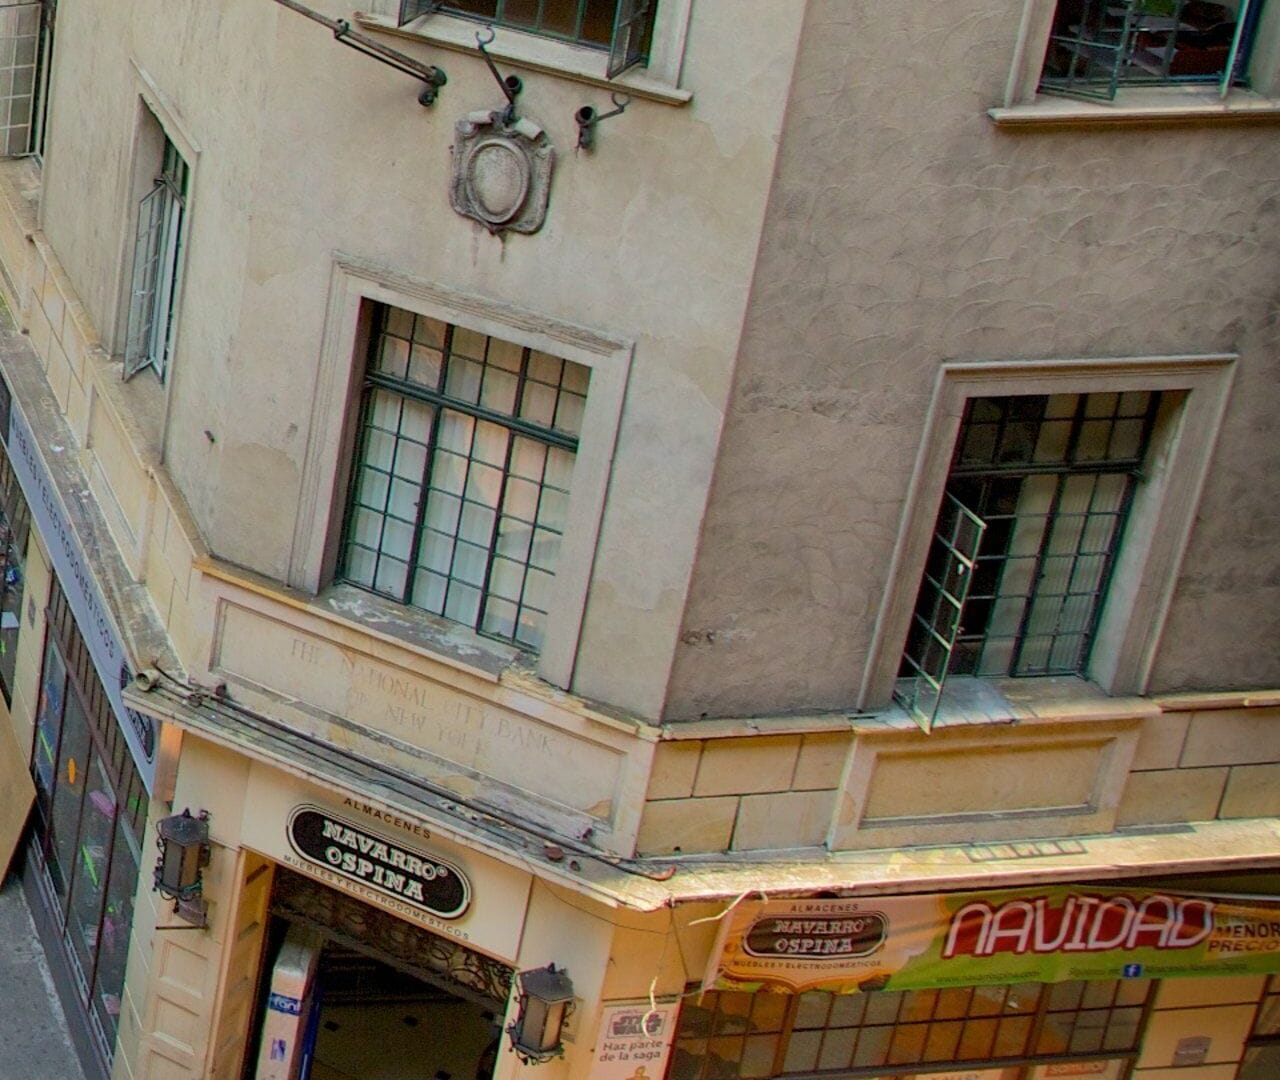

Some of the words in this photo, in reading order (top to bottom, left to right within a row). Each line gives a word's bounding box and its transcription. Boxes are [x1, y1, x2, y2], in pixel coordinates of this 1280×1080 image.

[343, 797, 432, 840] ALMACENES
[322, 819, 438, 881] NAVARRO
[283, 854, 335, 882] MUEBLES
[325, 846, 425, 902] OSPINA
[791, 903, 859, 913] ALMACENES
[772, 919, 865, 935] NAVARRO
[943, 892, 1215, 958] NAVIDAD
[775, 937, 854, 953] OSPINA
[599, 1053, 616, 1062] de
[619, 1052, 629, 1060] la
[634, 1051, 661, 1061] saga
[603, 1043, 626, 1051] Haz
[628, 1040, 663, 1052] parte
